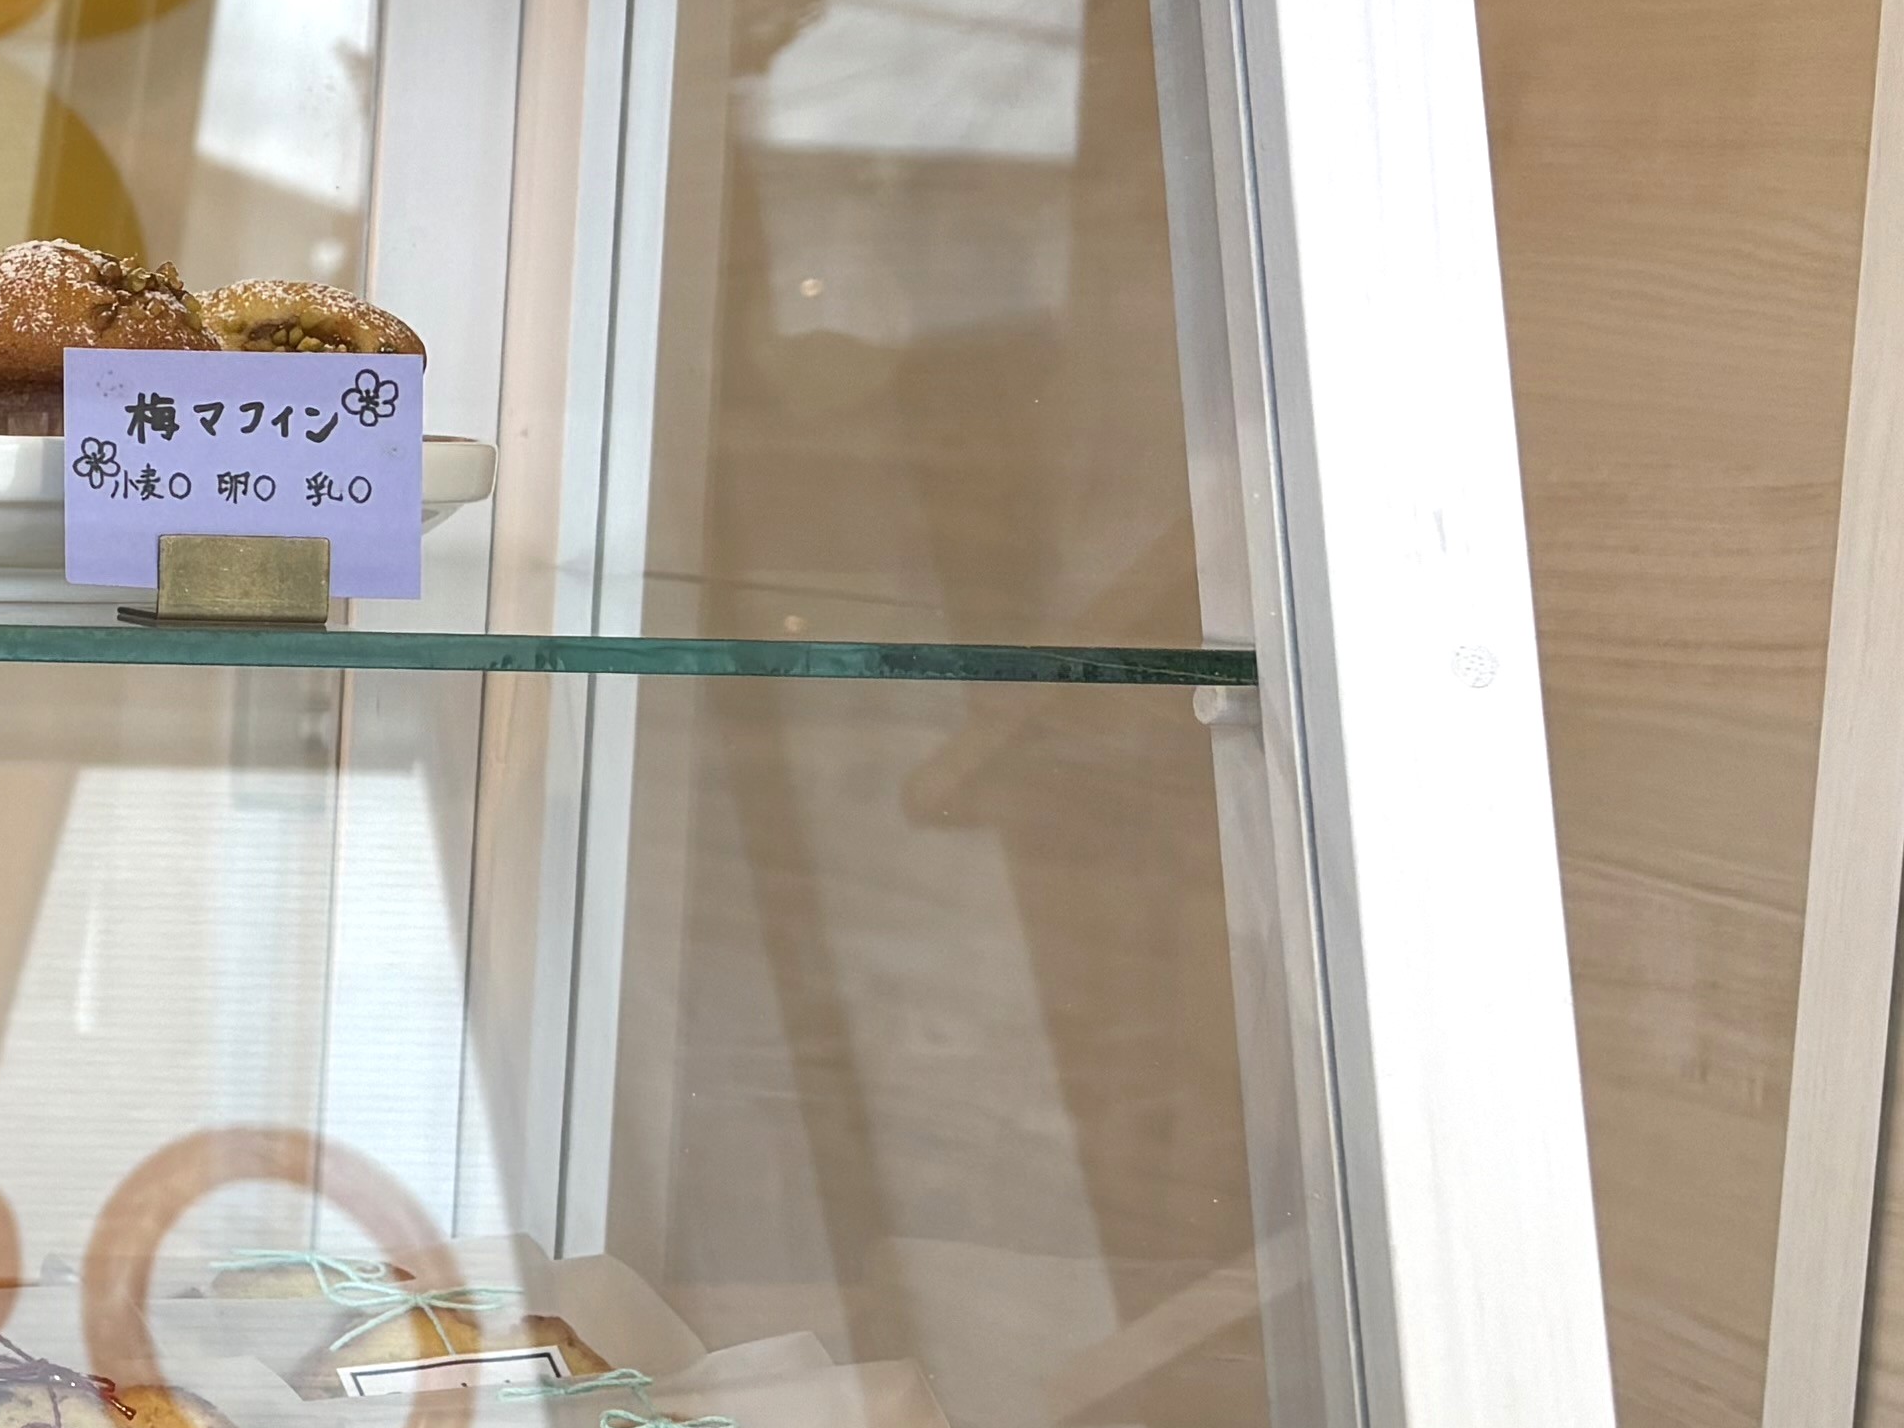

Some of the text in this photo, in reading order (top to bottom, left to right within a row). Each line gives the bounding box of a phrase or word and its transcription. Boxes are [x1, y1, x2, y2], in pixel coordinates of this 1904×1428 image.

[124, 392, 339, 444] 梅マフィン
